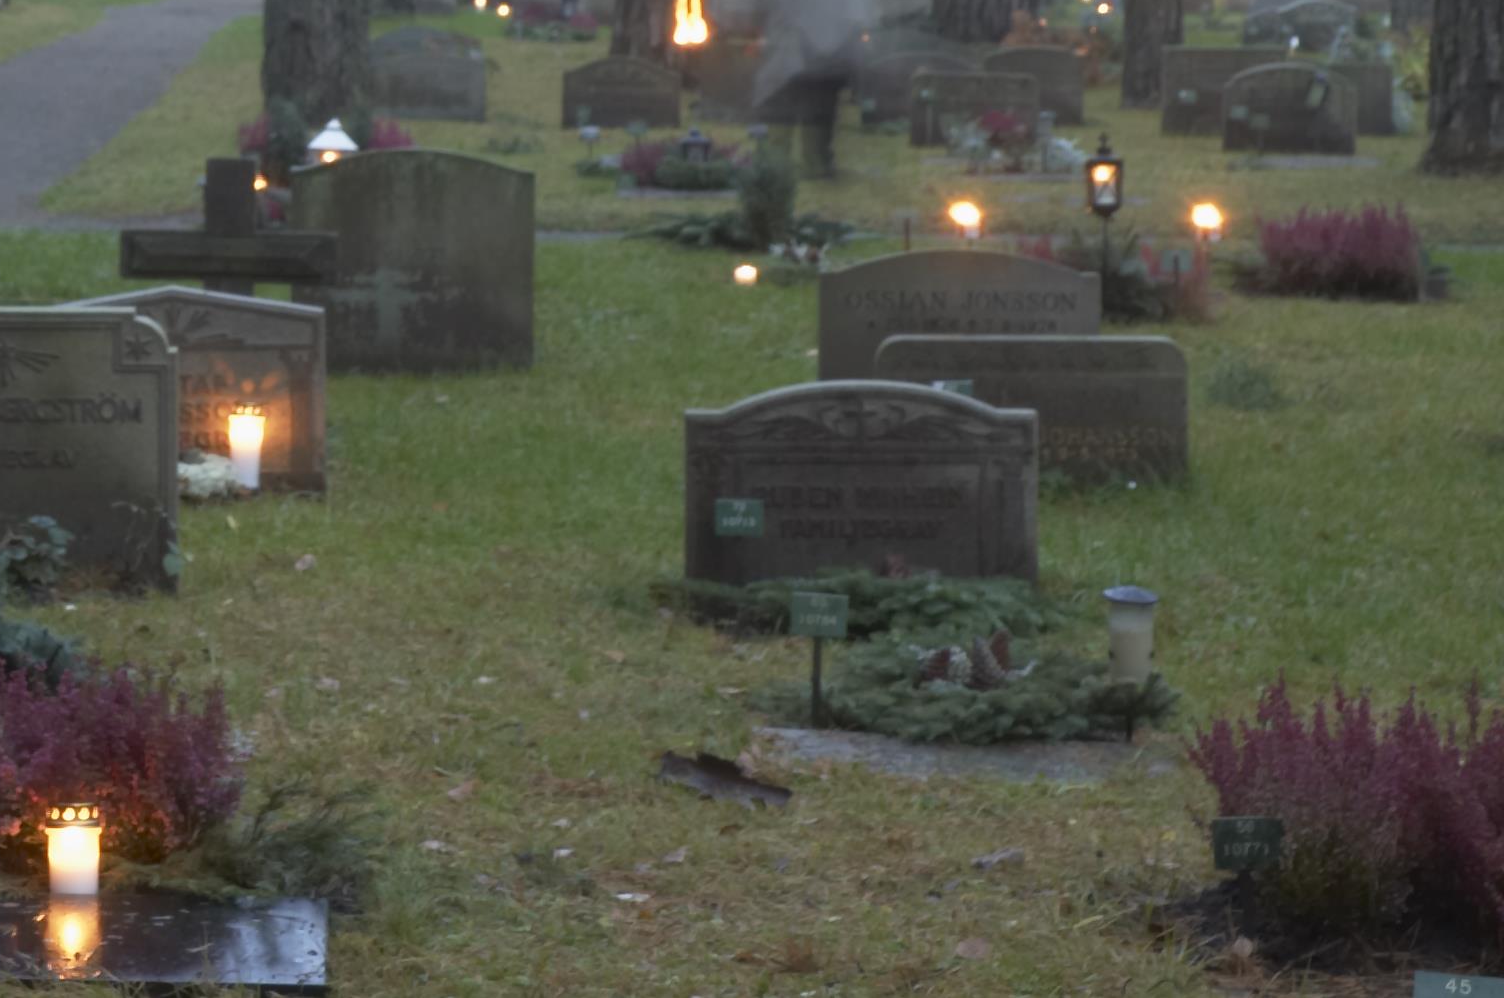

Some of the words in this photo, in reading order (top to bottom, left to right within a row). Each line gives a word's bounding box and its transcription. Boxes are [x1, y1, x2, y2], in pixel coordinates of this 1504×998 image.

[844, 289, 946, 311] OSSIAN
[960, 290, 1079, 313] JONSSON
[1444, 977, 1472, 995] 45
